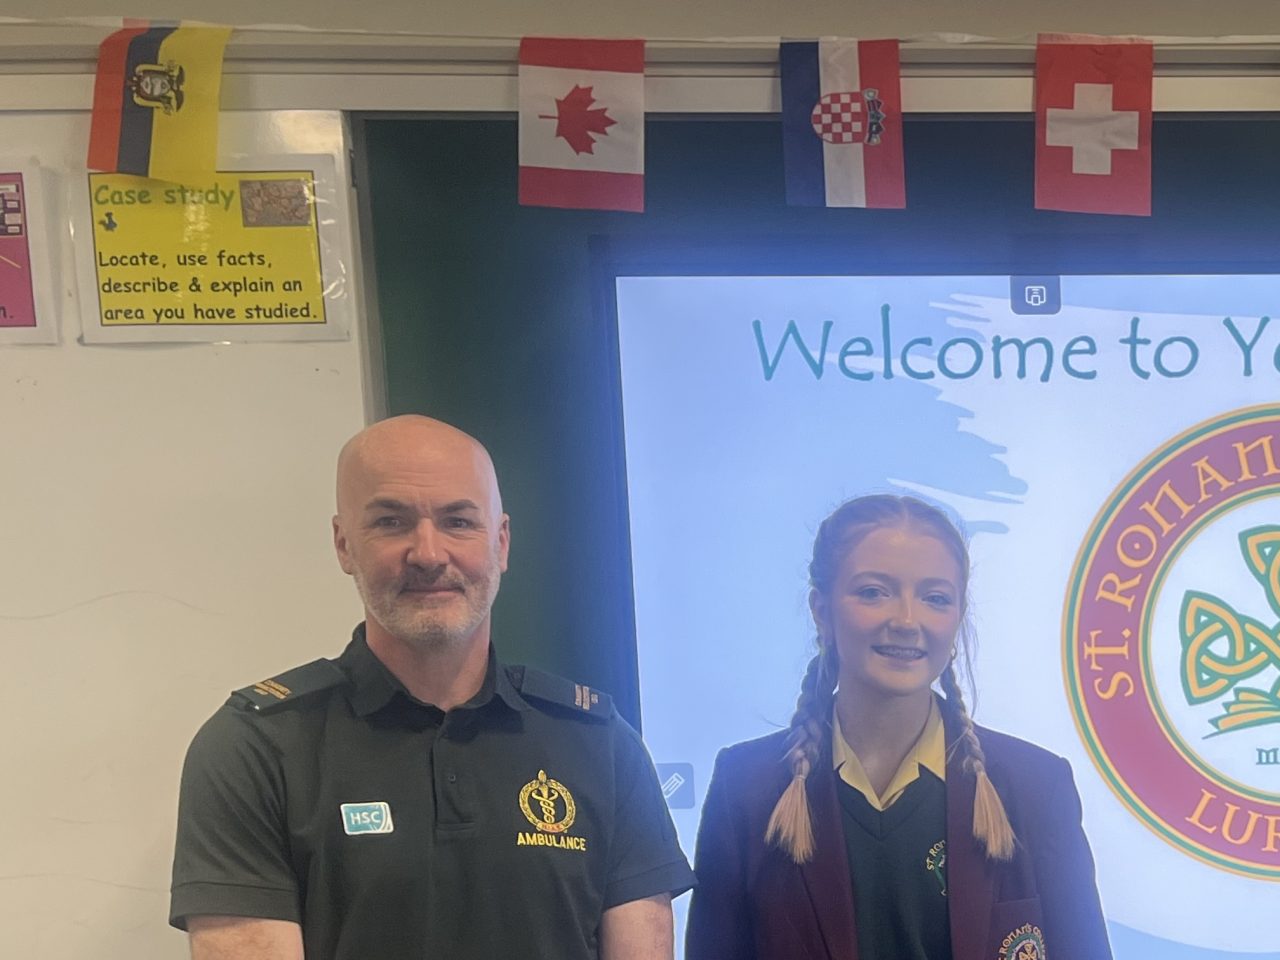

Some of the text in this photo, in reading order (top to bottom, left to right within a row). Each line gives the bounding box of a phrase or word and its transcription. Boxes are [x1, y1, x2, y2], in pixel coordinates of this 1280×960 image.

[94, 183, 235, 211] Case study
[99, 250, 272, 269] Locate, use facts,
[102, 277, 302, 297] describe & explain an
[104, 303, 317, 324] area you have studied.
[752, 304, 1098, 383] Welcome
[1119, 316, 1199, 380] to
[1084, 627, 1134, 701] ST.
[350, 811, 381, 826] HSC
[517, 832, 586, 851] AMBULANCE
